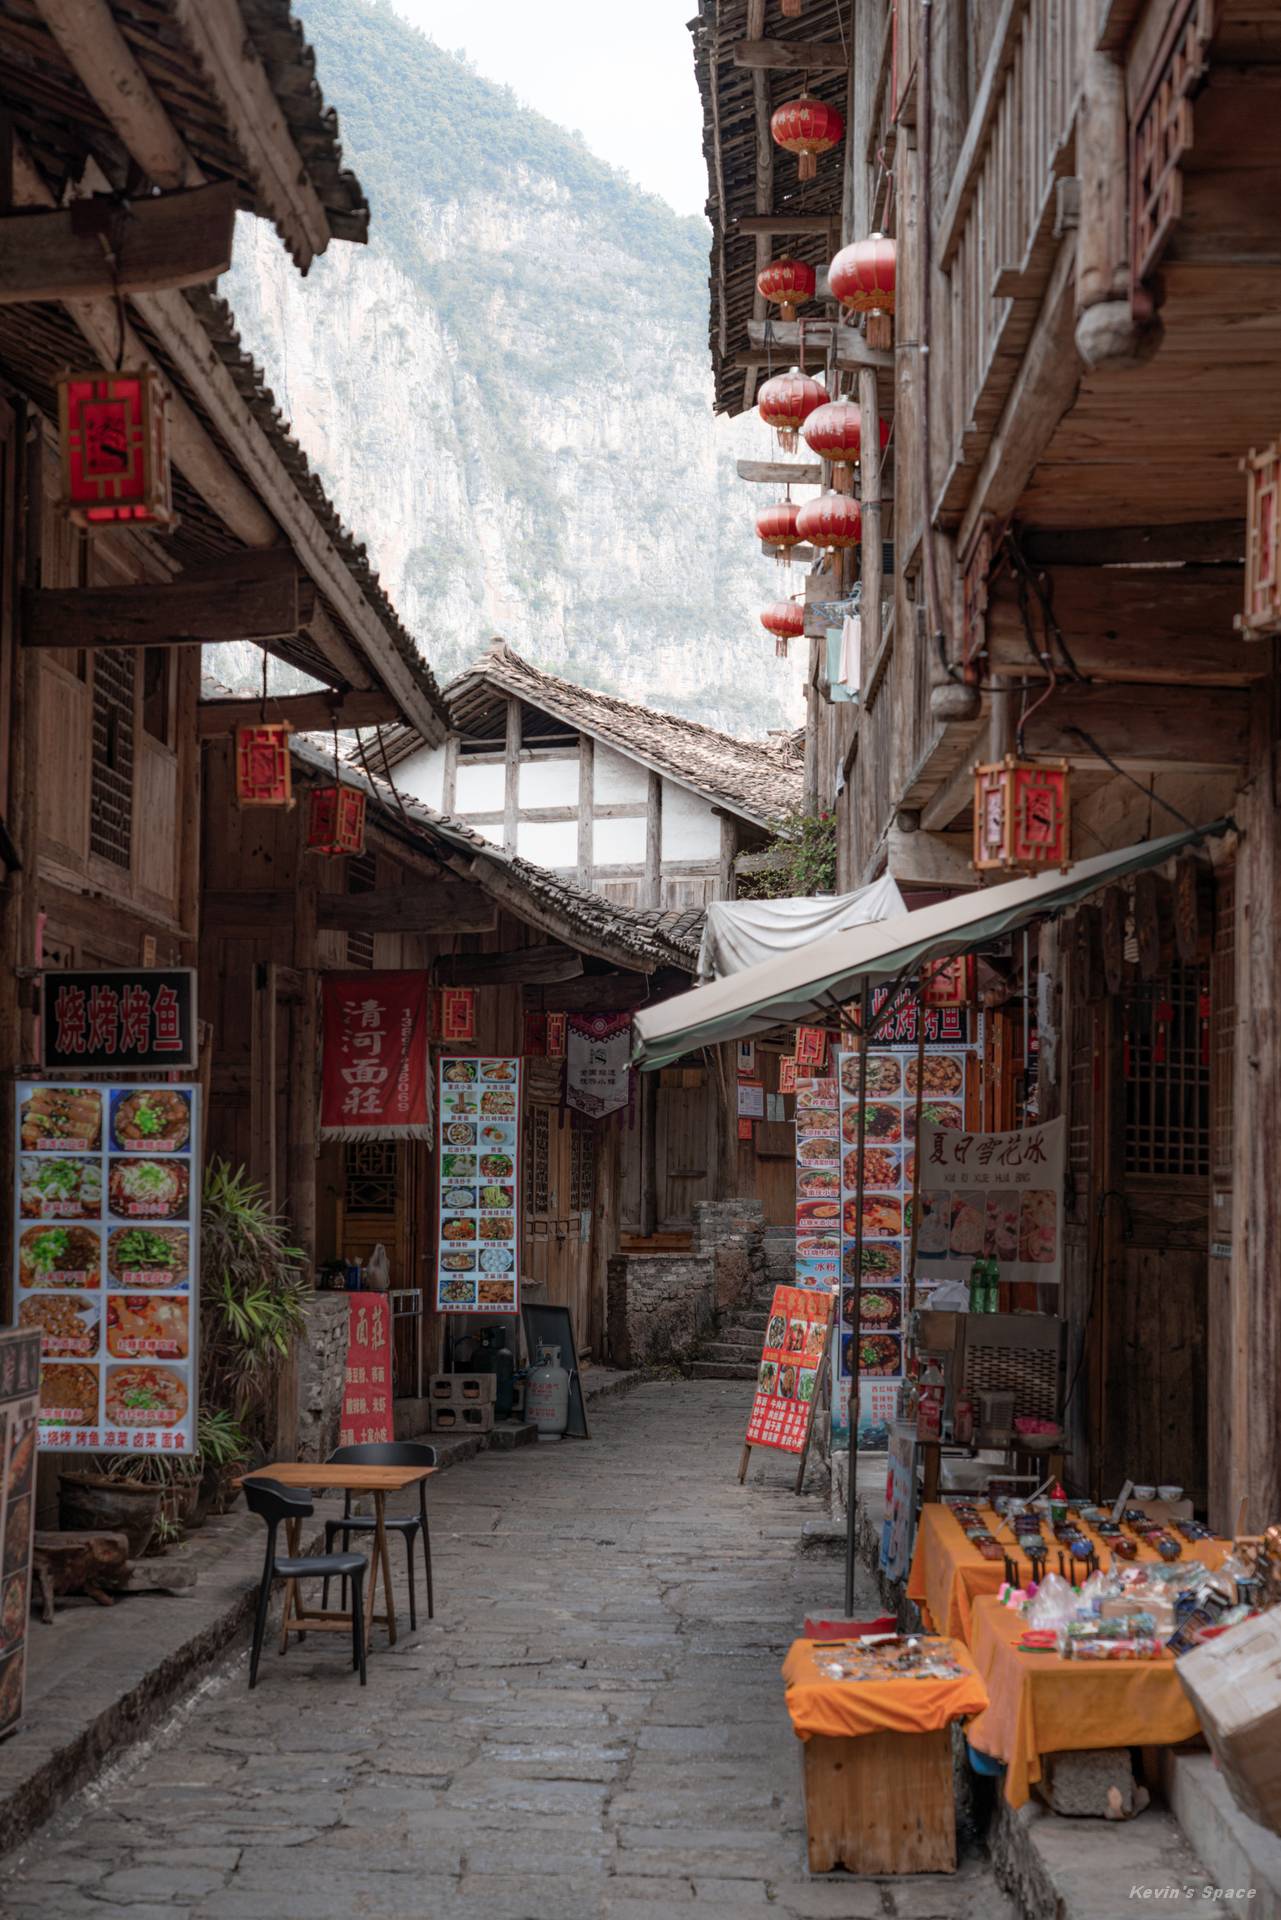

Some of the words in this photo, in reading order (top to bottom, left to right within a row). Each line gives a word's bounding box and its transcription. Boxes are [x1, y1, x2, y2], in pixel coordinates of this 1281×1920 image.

[55, 984, 182, 1055] 烧烤烤鱼
[929, 1130, 1047, 1166] 夏日雪花冰
[814, 1263, 836, 1272] 冰粉
[347, 1304, 386, 1350] 面莊
[76, 1432, 100, 1446] 烤鱼
[104, 1432, 129, 1447] 凉菜
[133, 1433, 157, 1448] 卤菜
[161, 1433, 186, 1449] 面食
